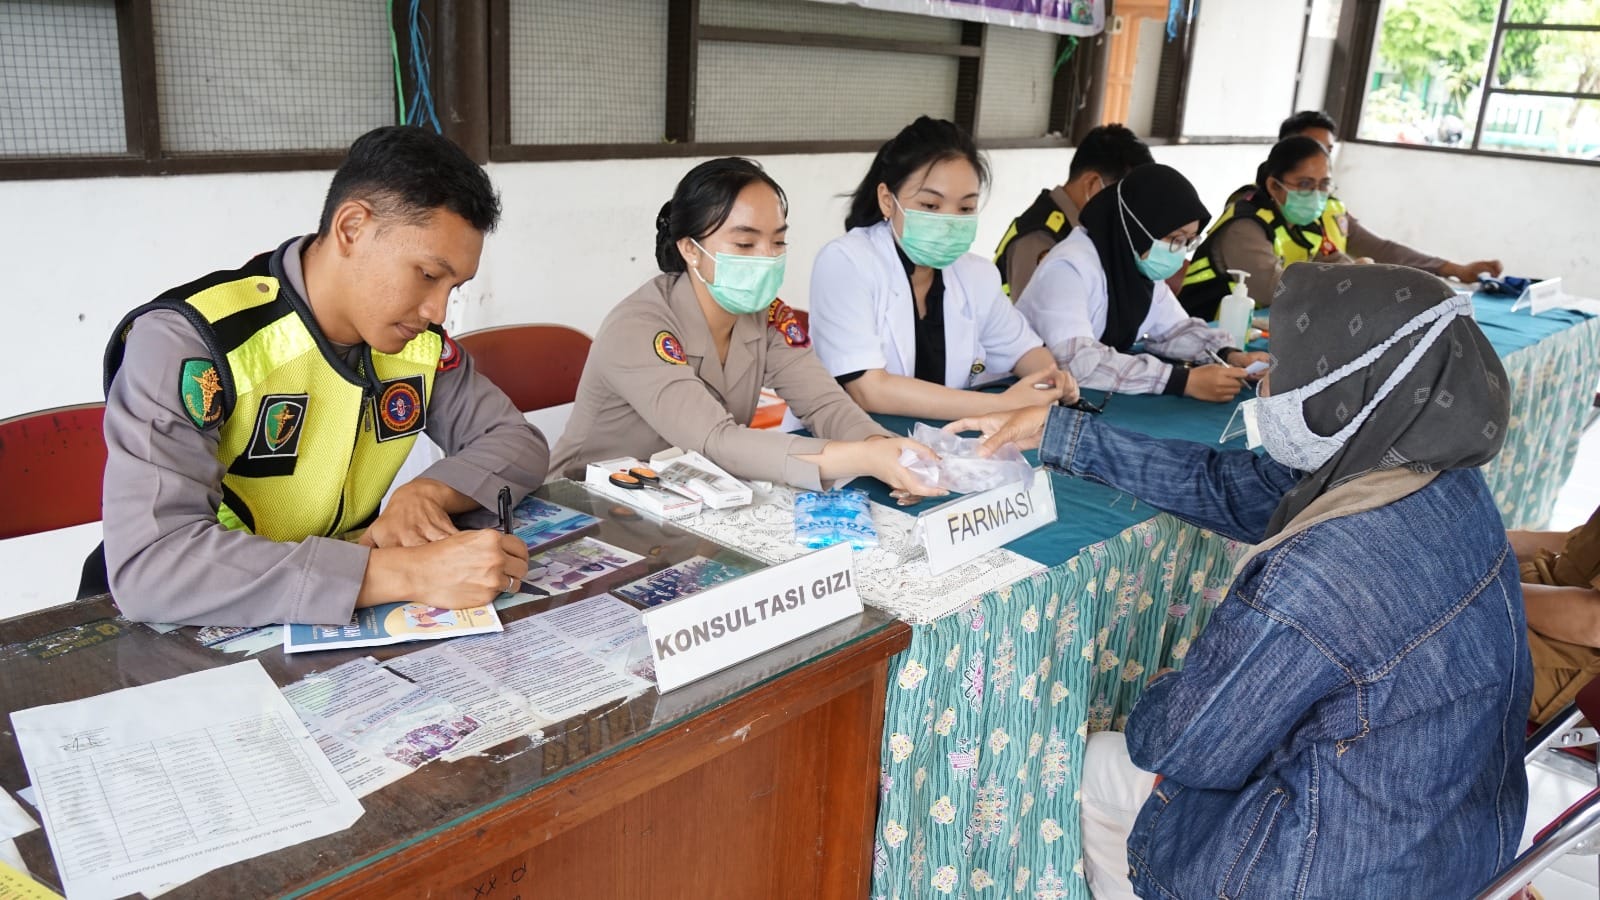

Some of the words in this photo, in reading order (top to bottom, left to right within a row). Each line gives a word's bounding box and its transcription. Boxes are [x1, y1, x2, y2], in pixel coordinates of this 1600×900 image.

[947, 489, 1034, 545] FARMASI
[655, 586, 805, 660] KONSULTASI
[812, 570, 851, 599] GIZI
